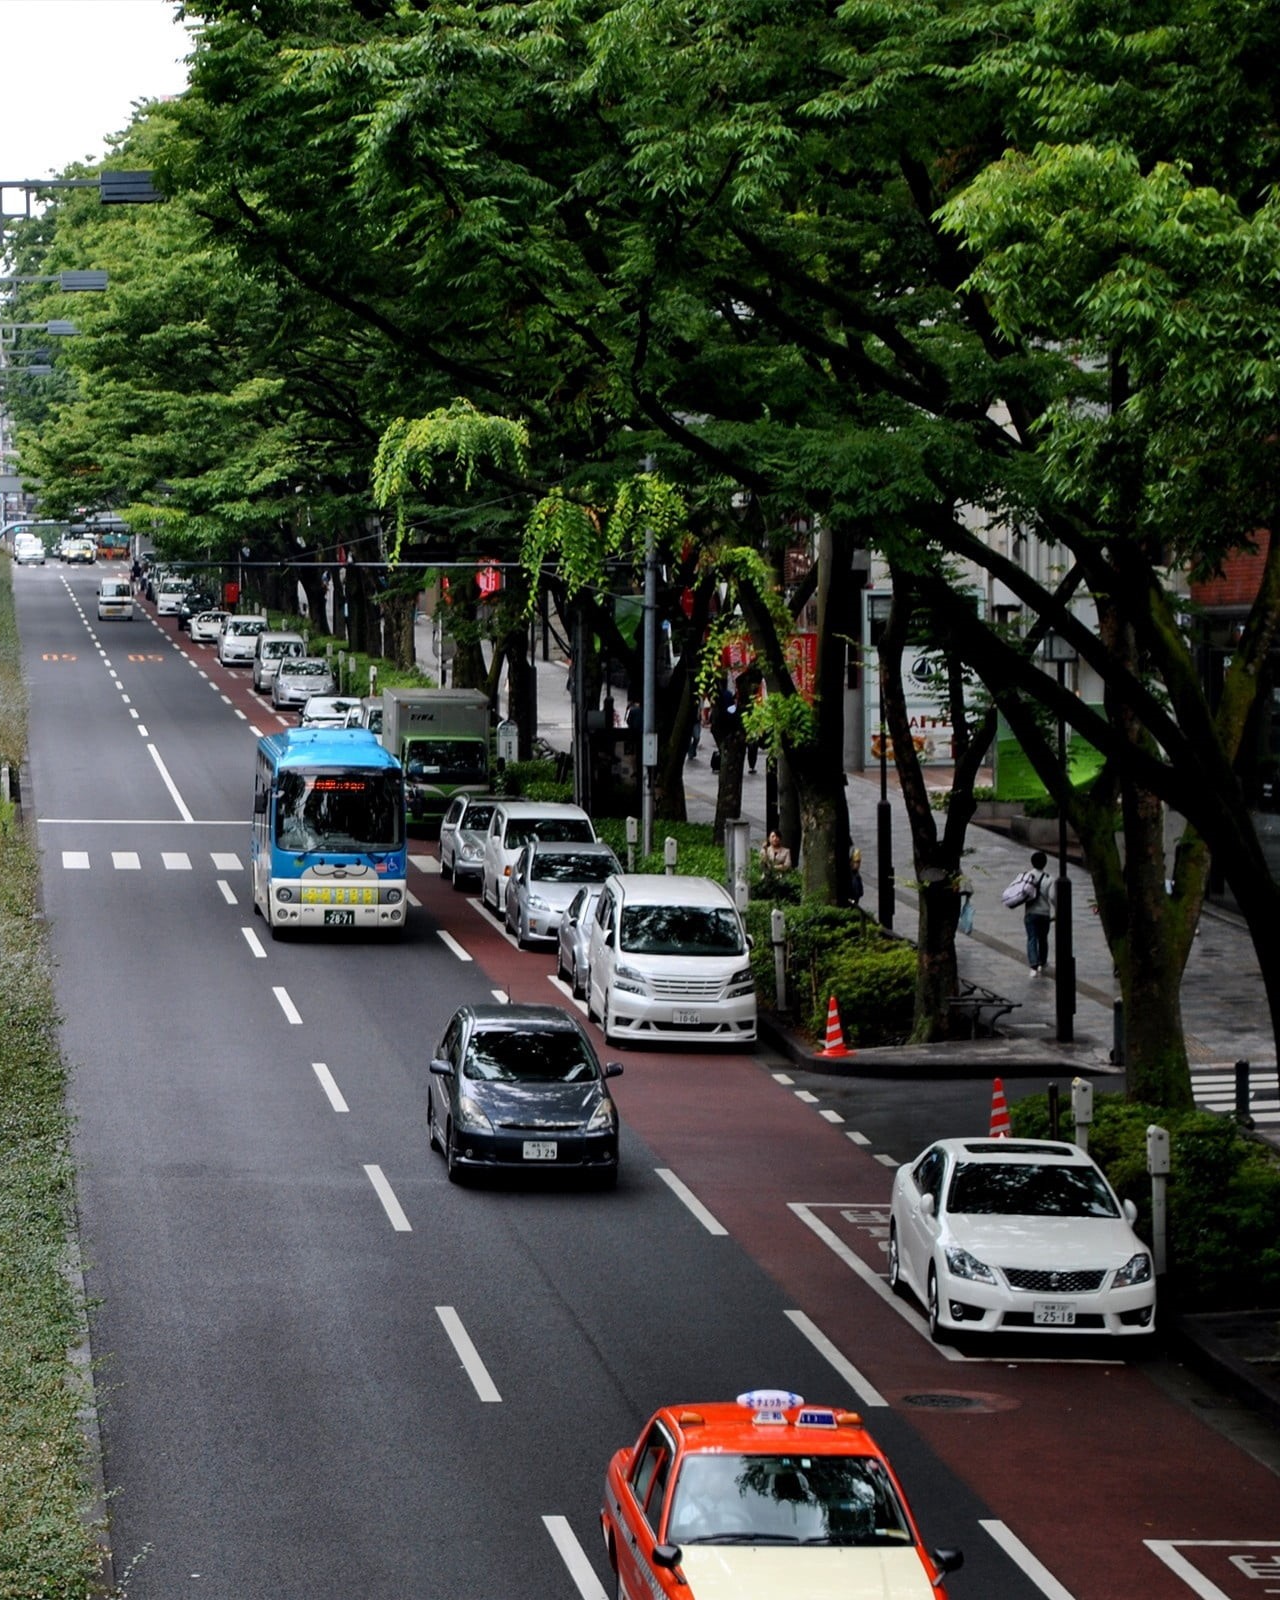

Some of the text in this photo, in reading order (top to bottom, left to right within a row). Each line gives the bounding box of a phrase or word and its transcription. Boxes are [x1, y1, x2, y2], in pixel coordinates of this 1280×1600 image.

[1042, 1311, 1074, 1323] 25-18
[756, 1398, 787, 1409] チェッカー
